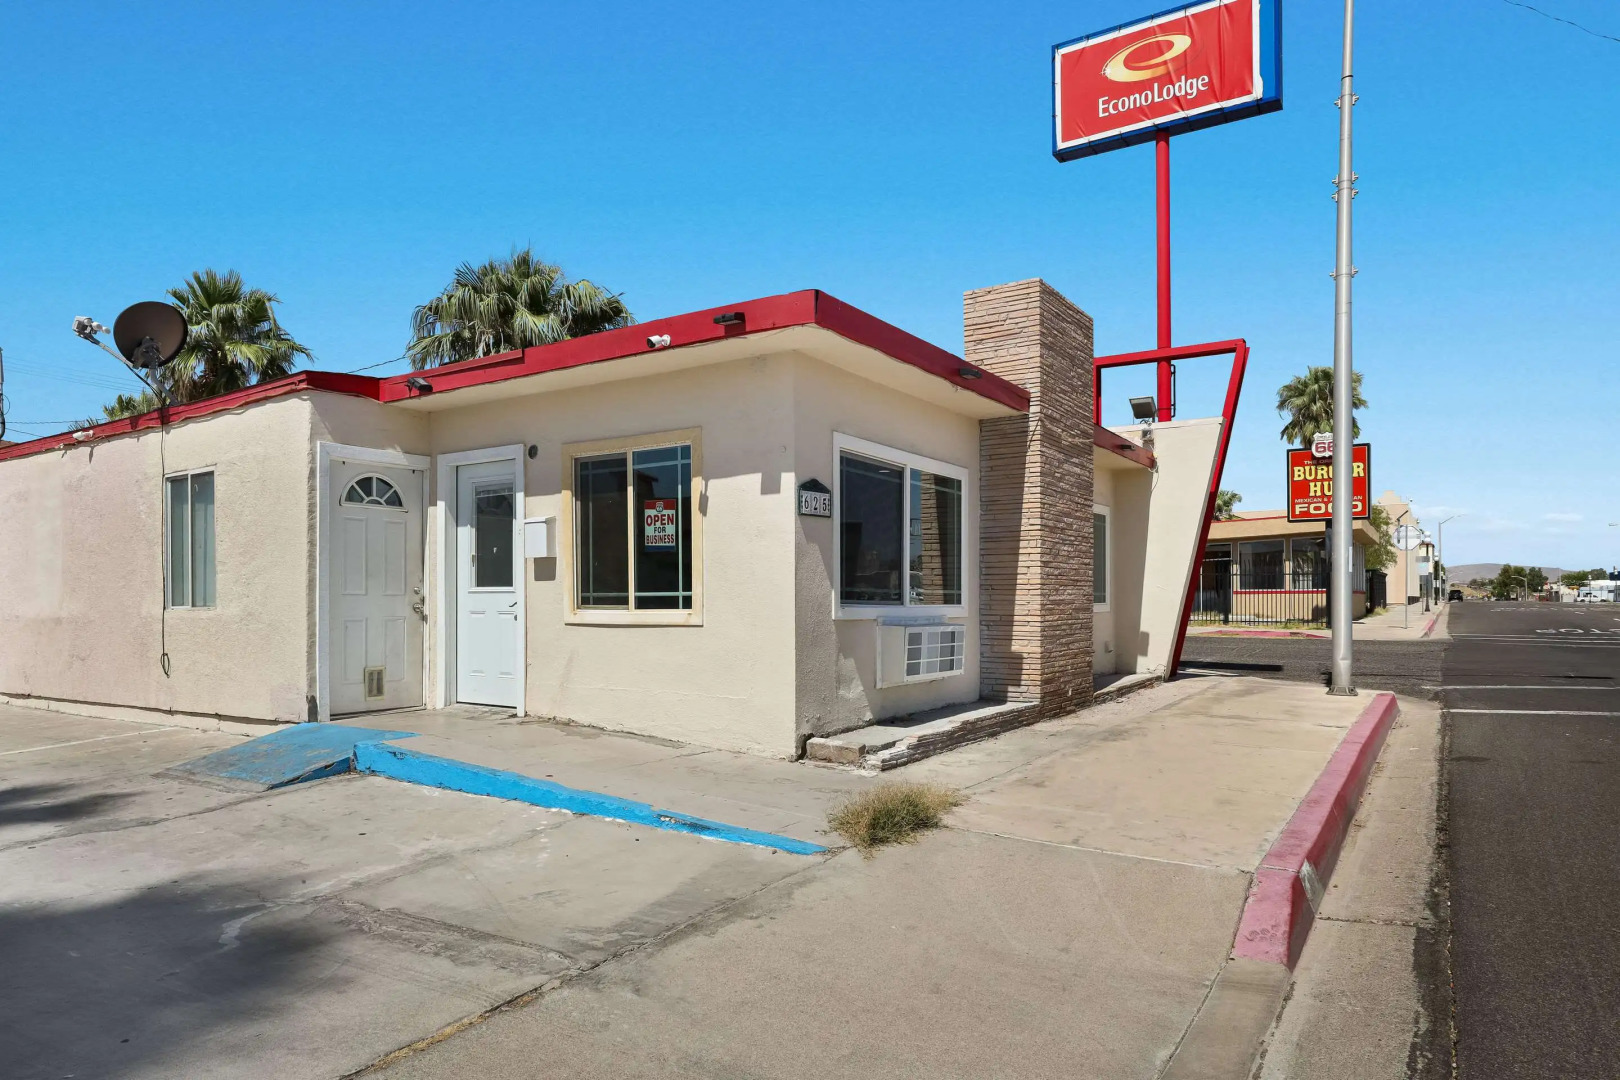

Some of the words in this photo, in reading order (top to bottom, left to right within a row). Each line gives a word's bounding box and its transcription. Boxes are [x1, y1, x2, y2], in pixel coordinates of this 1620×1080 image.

[1098, 74, 1209, 117] EconoLodge
[1294, 462, 1364, 481] BURR
[1309, 481, 1333, 496] HU
[804, 495, 827, 511] 625
[1295, 502, 1363, 514] FOD
[646, 514, 674, 526] OPEN
[646, 534, 674, 544] BUSINESS
